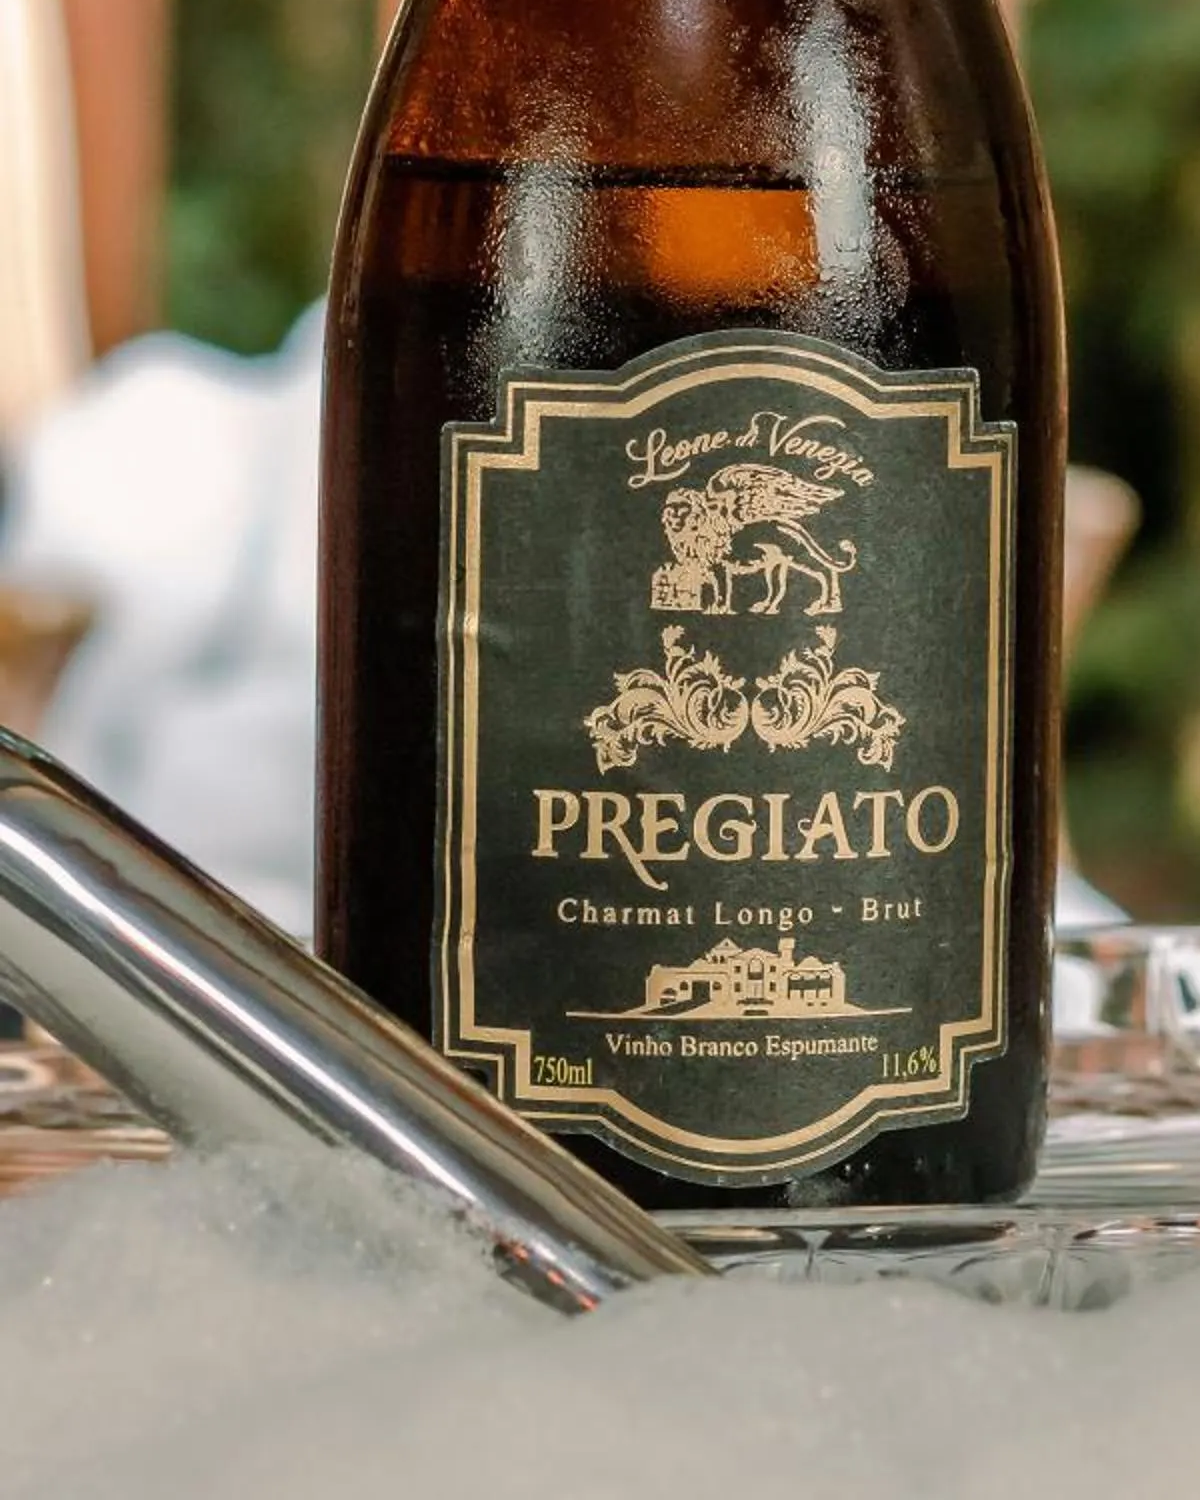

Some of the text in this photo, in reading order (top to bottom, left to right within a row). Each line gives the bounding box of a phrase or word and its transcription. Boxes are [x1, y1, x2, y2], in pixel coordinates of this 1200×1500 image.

[625, 412, 875, 488] Leone di Venezia
[531, 785, 959, 890] PREGIATO
[557, 899, 695, 925] Charmat
[715, 901, 814, 931] Longo
[861, 897, 923, 922] Brut
[605, 1033, 879, 1061] Vinho Branco Espumante
[533, 1055, 593, 1085] 750ml
